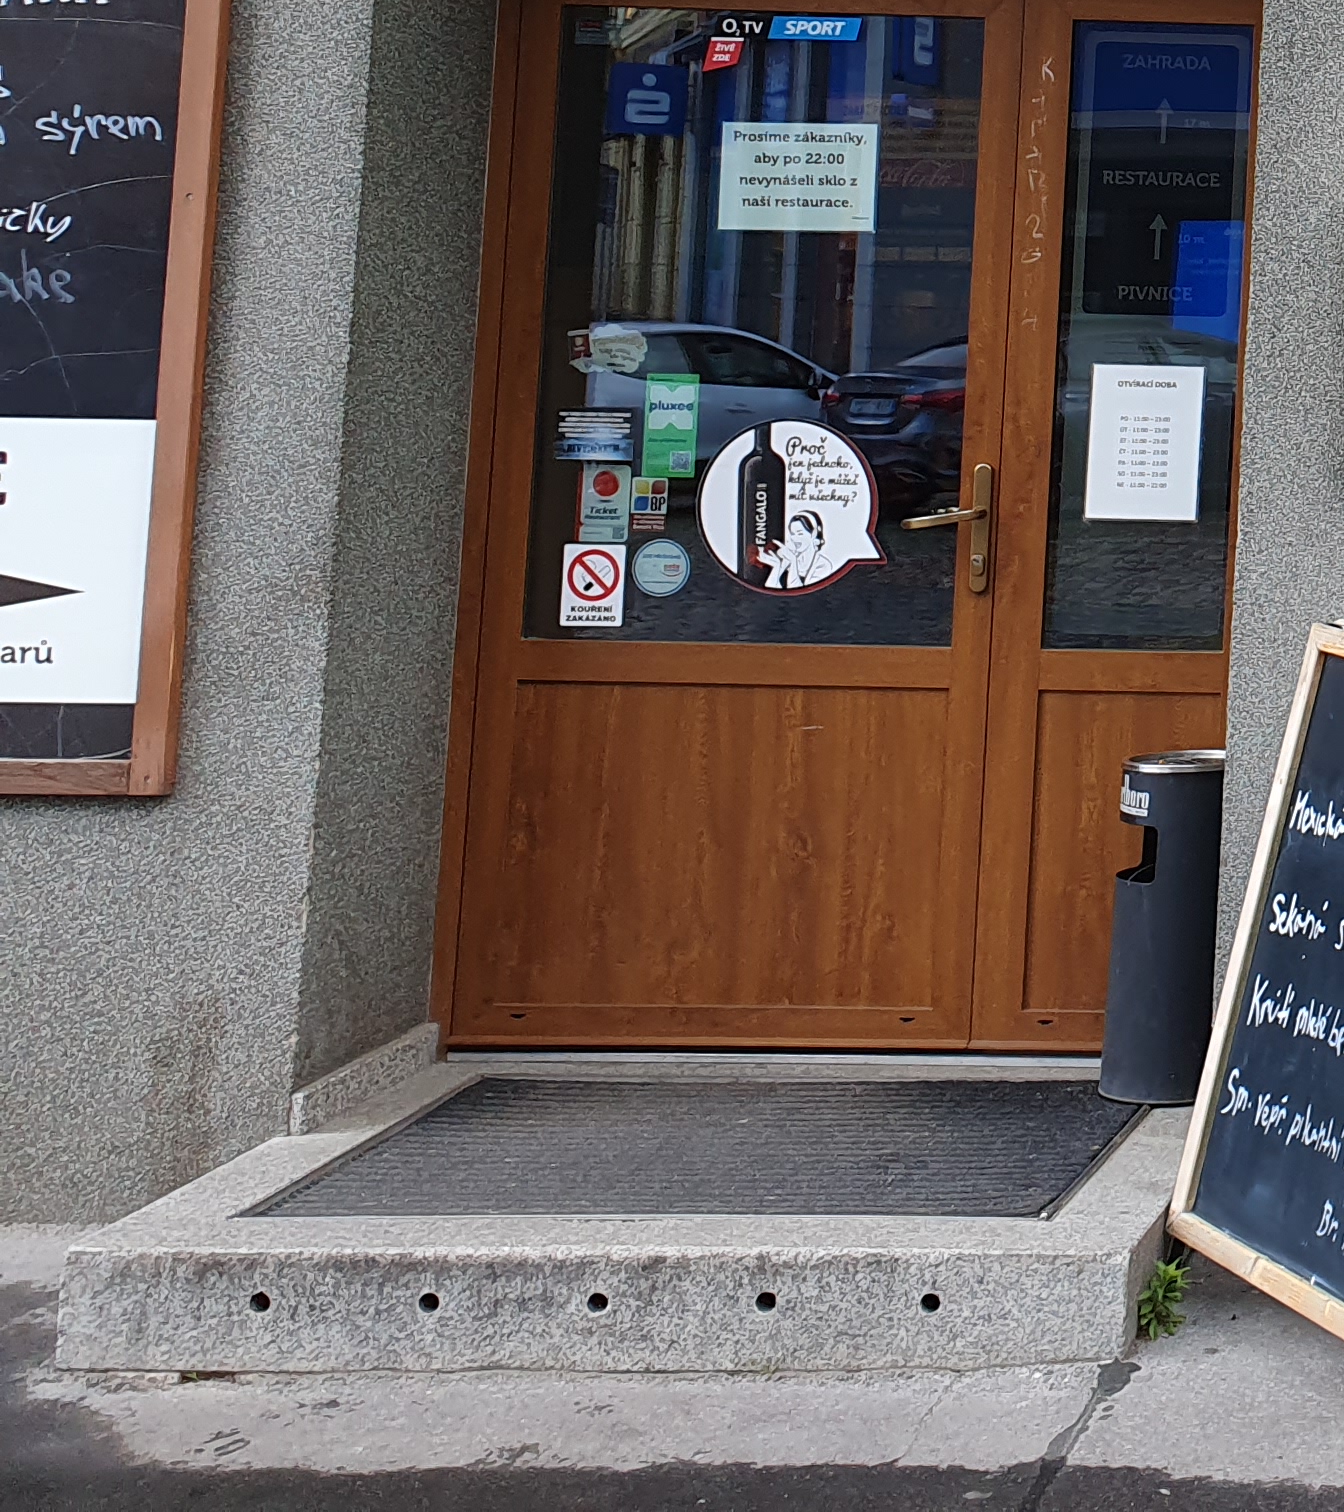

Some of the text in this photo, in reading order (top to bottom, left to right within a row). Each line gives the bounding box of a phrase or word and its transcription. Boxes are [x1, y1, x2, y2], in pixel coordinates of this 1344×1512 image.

[742, 21, 763, 34] TV
[783, 20, 846, 36] SPORT
[1122, 54, 1211, 71] ZAHRADA
[35, 104, 163, 155] sýrem
[733, 130, 868, 146] Prosíme zákazníky,
[754, 153, 845, 167] aby po 22:00
[739, 174, 858, 188] nevynášeli sklo z
[1102, 169, 1220, 187] RESTAURACE
[742, 195, 853, 208] naší restaurace.
[1117, 285, 1193, 302] PIVNICE
[1155, 380, 1178, 388] DOBA
[649, 400, 694, 413] pluxee
[786, 436, 828, 457] Proč
[787, 458, 806, 471] jen
[814, 474, 826, 488] je
[589, 505, 619, 515] Ticket
[650, 496, 666, 512] BP
[570, 604, 613, 613] KOUŘENÍ
[565, 614, 617, 622] ZAKÁZÁNO
